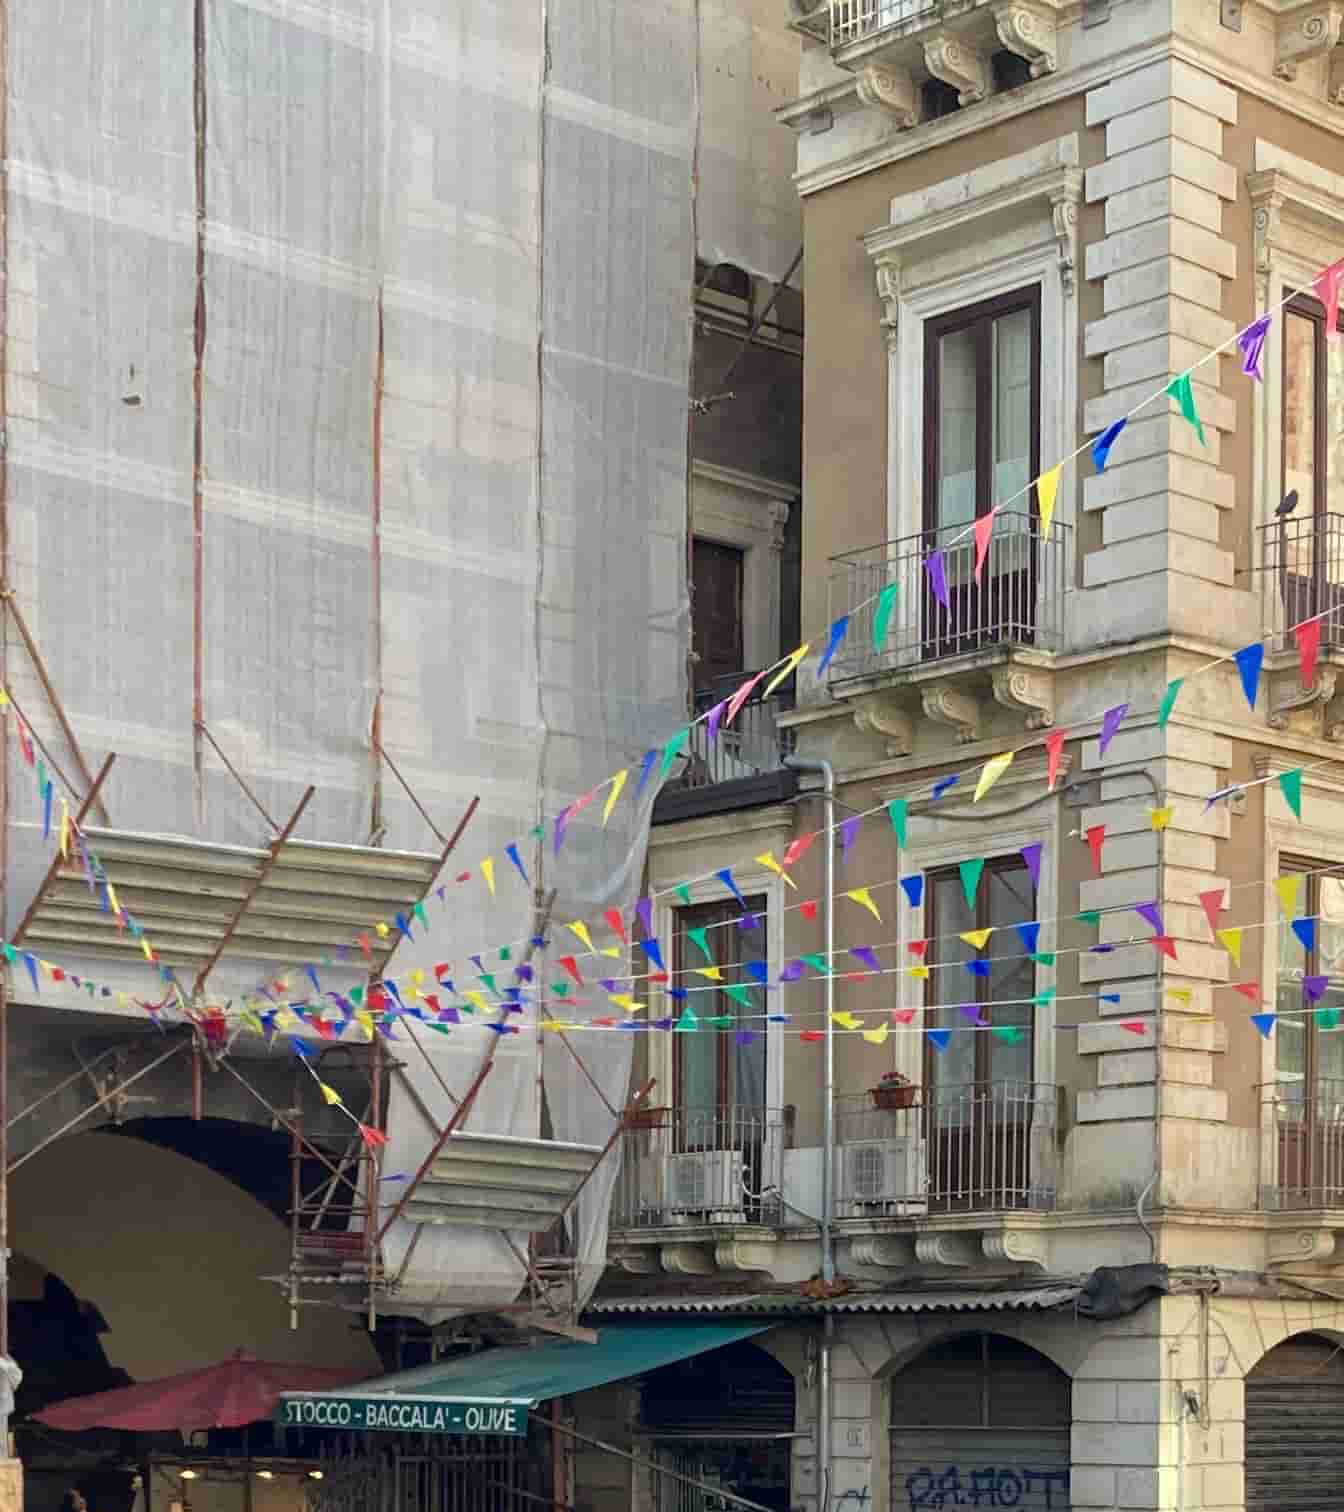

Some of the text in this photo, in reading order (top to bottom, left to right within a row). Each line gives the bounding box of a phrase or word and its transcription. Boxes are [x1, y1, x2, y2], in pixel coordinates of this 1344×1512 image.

[287, 1401, 351, 1424] STOCCO
[366, 1404, 449, 1429] BACCALA'
[465, 1407, 517, 1431] OLIVE
